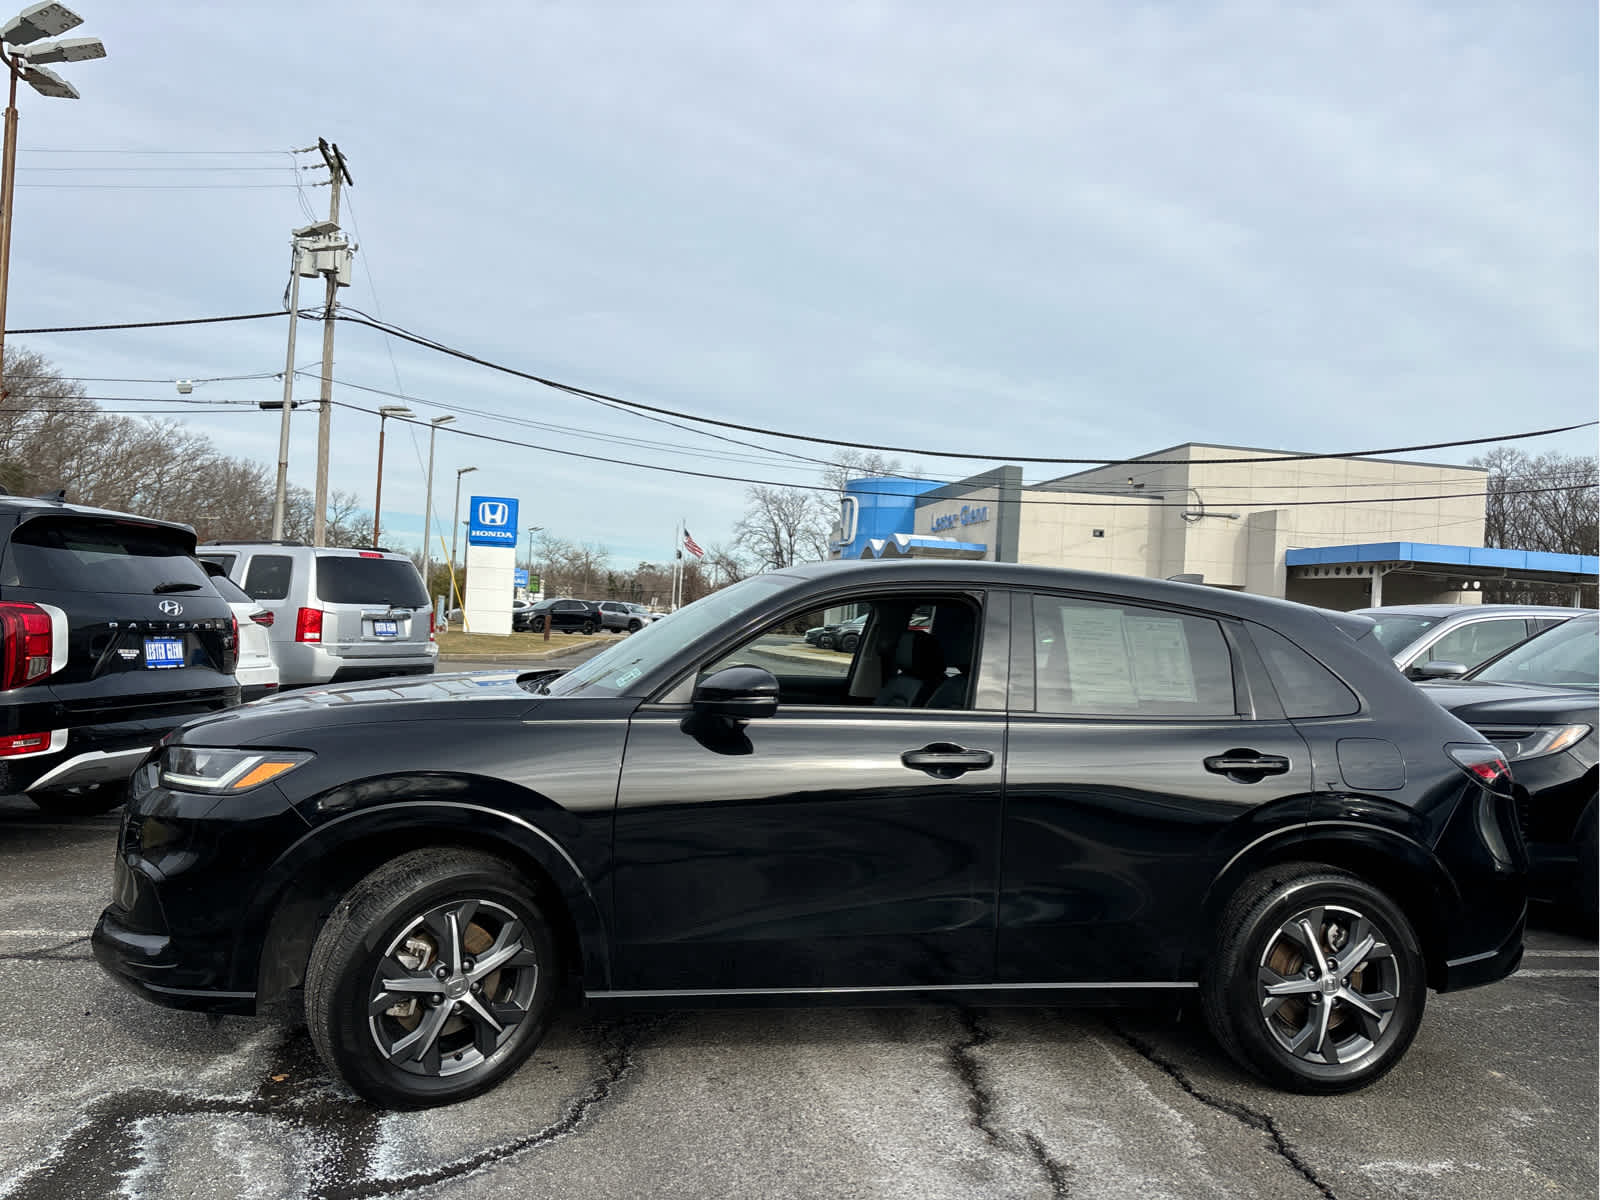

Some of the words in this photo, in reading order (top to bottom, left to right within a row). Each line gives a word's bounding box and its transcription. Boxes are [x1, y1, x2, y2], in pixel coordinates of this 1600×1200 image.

[931, 512, 960, 532] Lester
[471, 530, 513, 538] HONDA
[145, 642, 166, 660] LESTER
[166, 642, 183, 660] GLENN
